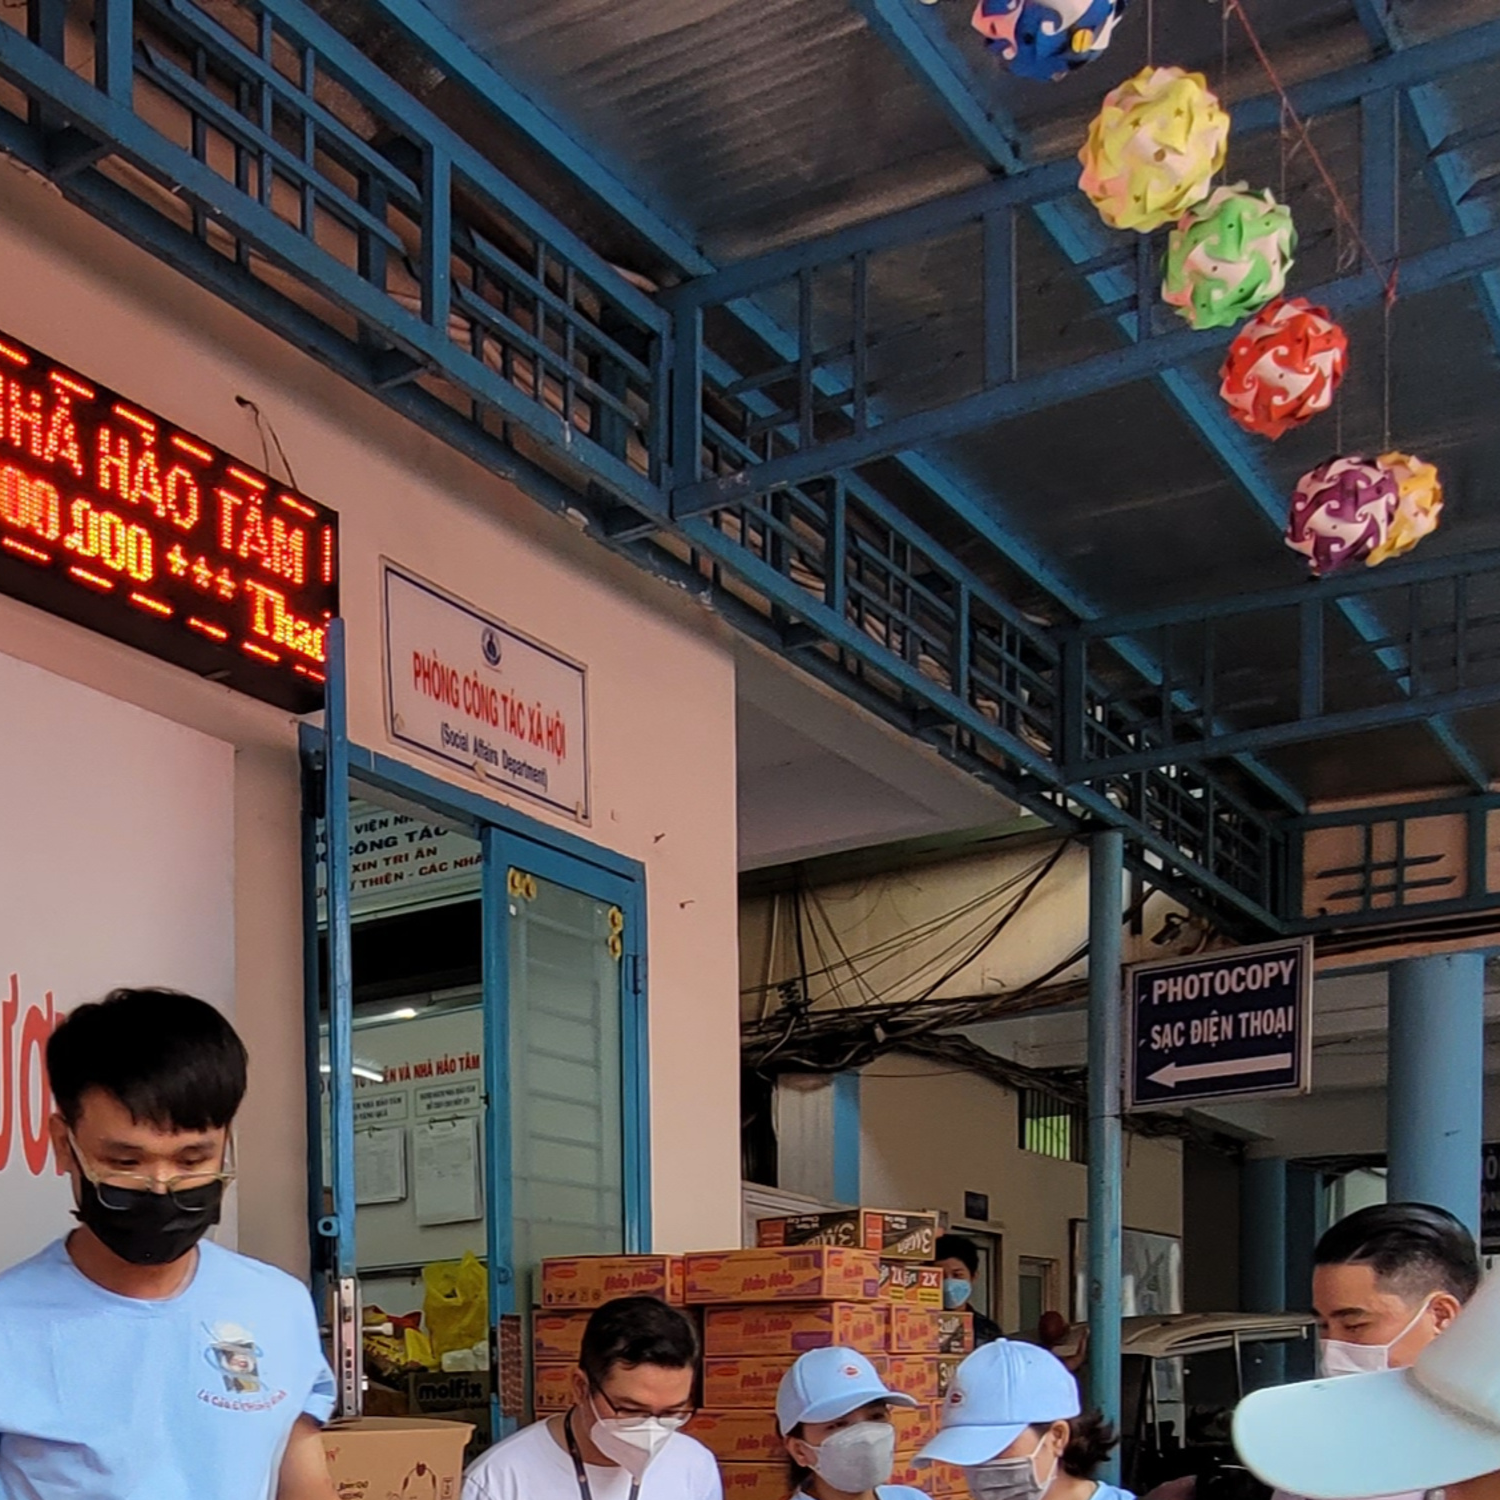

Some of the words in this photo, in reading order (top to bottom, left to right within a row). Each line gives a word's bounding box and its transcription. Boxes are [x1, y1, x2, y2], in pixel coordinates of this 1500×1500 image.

[412, 648, 460, 709] PHÒNG
[463, 669, 499, 728] CÔNG
[501, 687, 526, 740] TÁC
[546, 709, 567, 766] HỘI
[352, 858, 378, 875] XIN
[383, 852, 409, 867] TRI
[360, 871, 404, 890] THIỆN
[1152, 958, 1296, 1006] PHOTOCOPY
[1150, 1021, 1186, 1055] SẠC
[1190, 1010, 1234, 1048] ĐIỆN
[1238, 1005, 1294, 1040] THOẠI
[399, 1061, 413, 1082] VÀ
[417, 1376, 483, 1399] molfix
